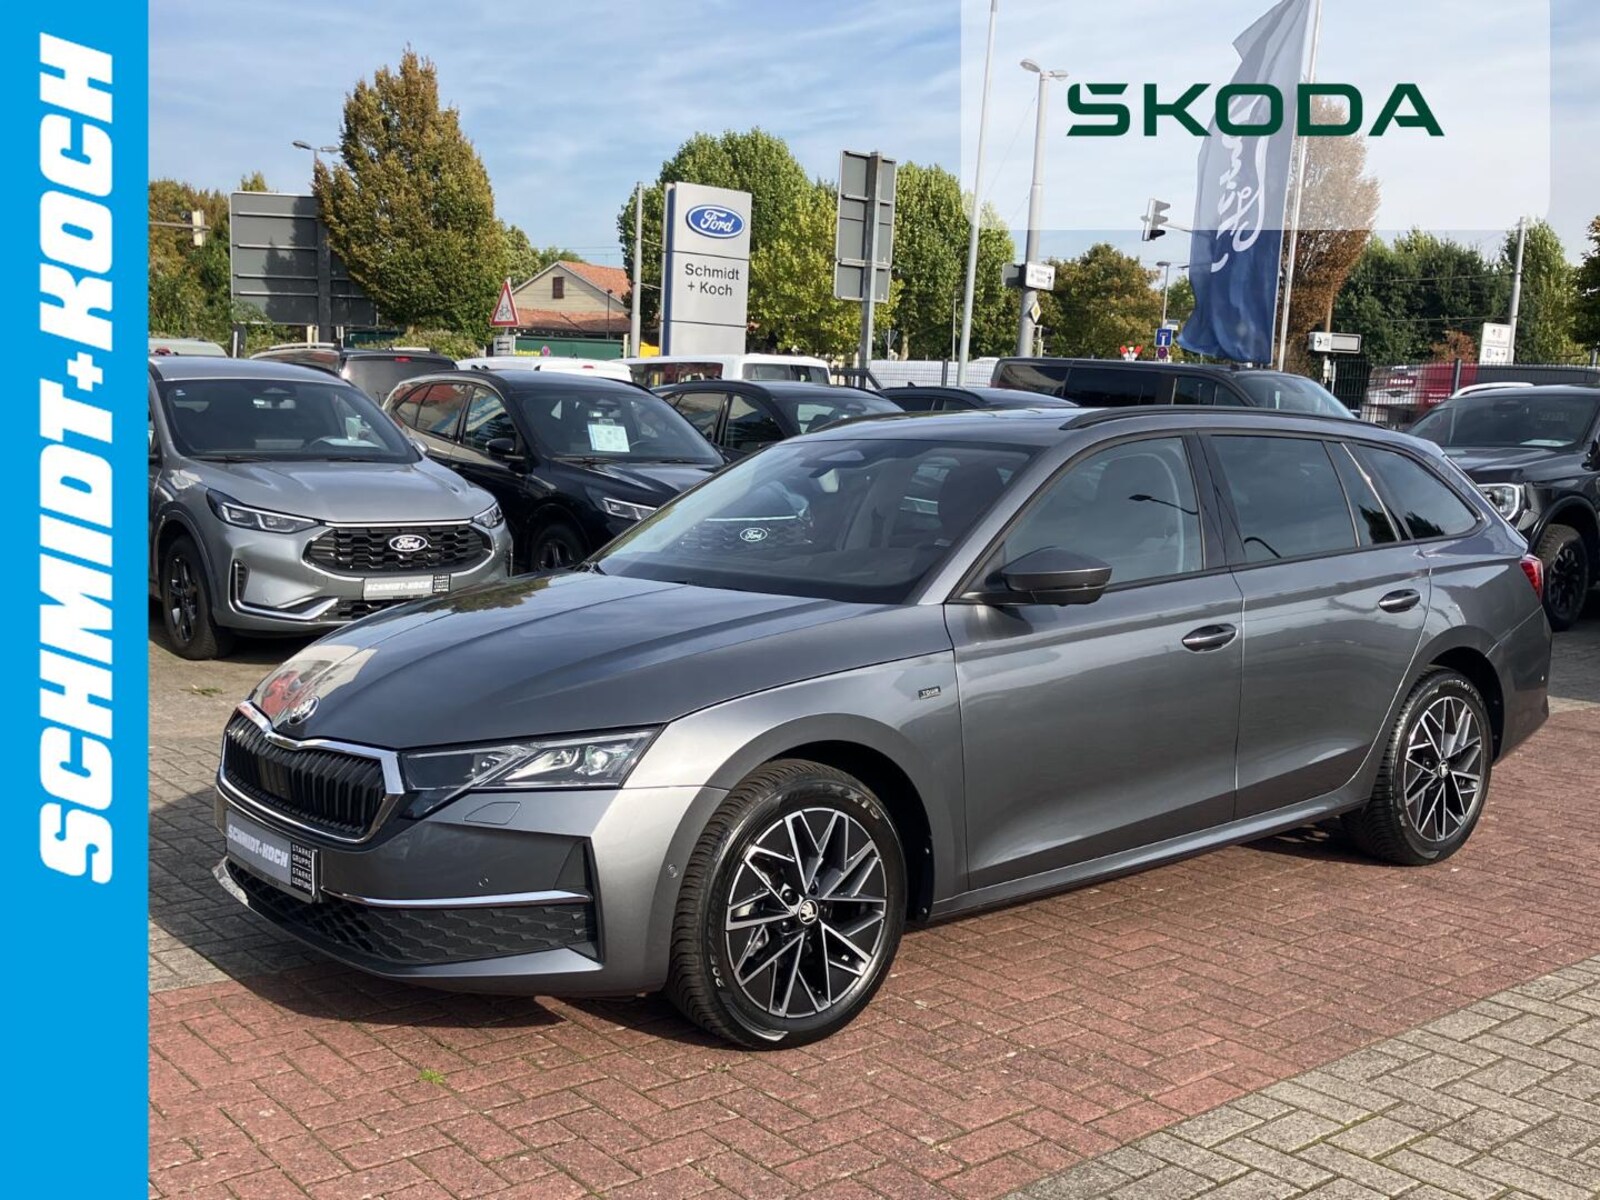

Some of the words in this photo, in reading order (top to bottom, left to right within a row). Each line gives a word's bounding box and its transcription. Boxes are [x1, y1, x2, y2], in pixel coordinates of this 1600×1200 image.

[700, 209, 735, 233] Ford
[685, 263, 739, 281] Schmidt
[687, 281, 695, 292] +
[699, 281, 733, 297] Koch
[744, 529, 763, 540] Ford
[395, 537, 421, 549] Ford
